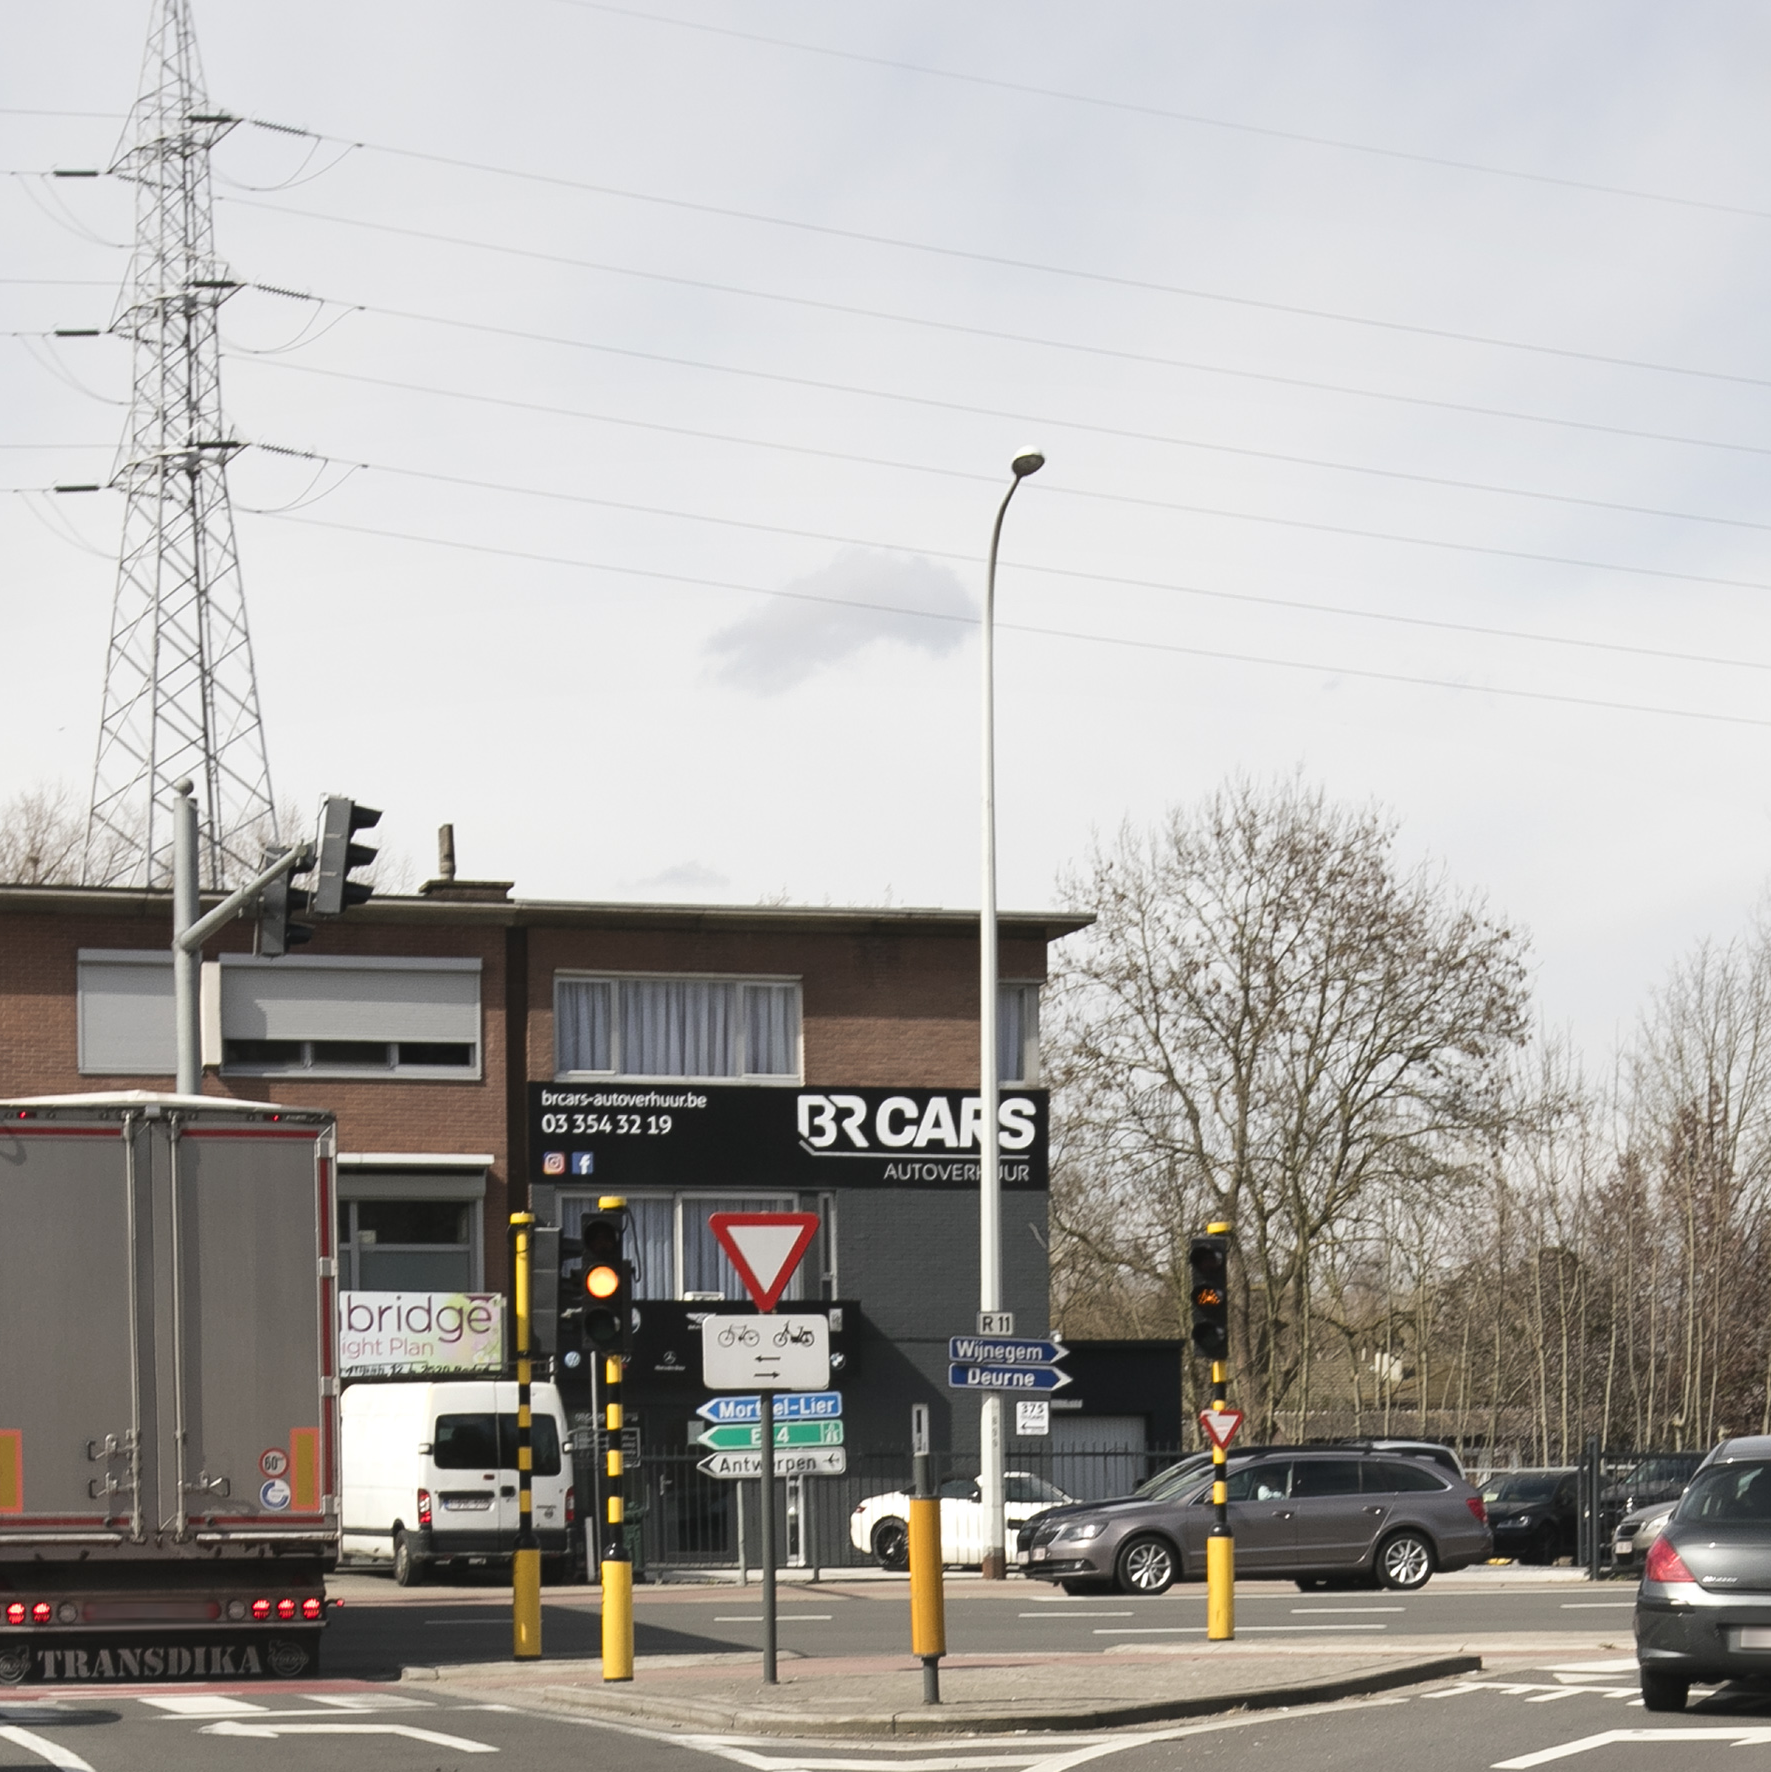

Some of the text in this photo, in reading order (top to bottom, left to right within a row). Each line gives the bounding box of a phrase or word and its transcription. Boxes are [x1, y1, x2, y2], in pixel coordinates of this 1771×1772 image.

[541, 1089, 707, 1108] brcars-autoverhuur.be
[541, 1113, 672, 1135] 03 354 32 19
[797, 1094, 870, 1148] BR
[883, 1163, 1030, 1182] AUTOVERUR
[339, 1294, 492, 1343] bridge
[982, 1316, 1010, 1332] R 11
[342, 1337, 434, 1359] ight Plan
[956, 1340, 1043, 1364] Wijnegem
[967, 1367, 1035, 1387] Deurne
[718, 1397, 836, 1419] Mortel-Lier
[751, 1426, 790, 1445] E4
[719, 1456, 816, 1475] Antwrpen
[37, 1645, 263, 1679] TRANSDIKA
